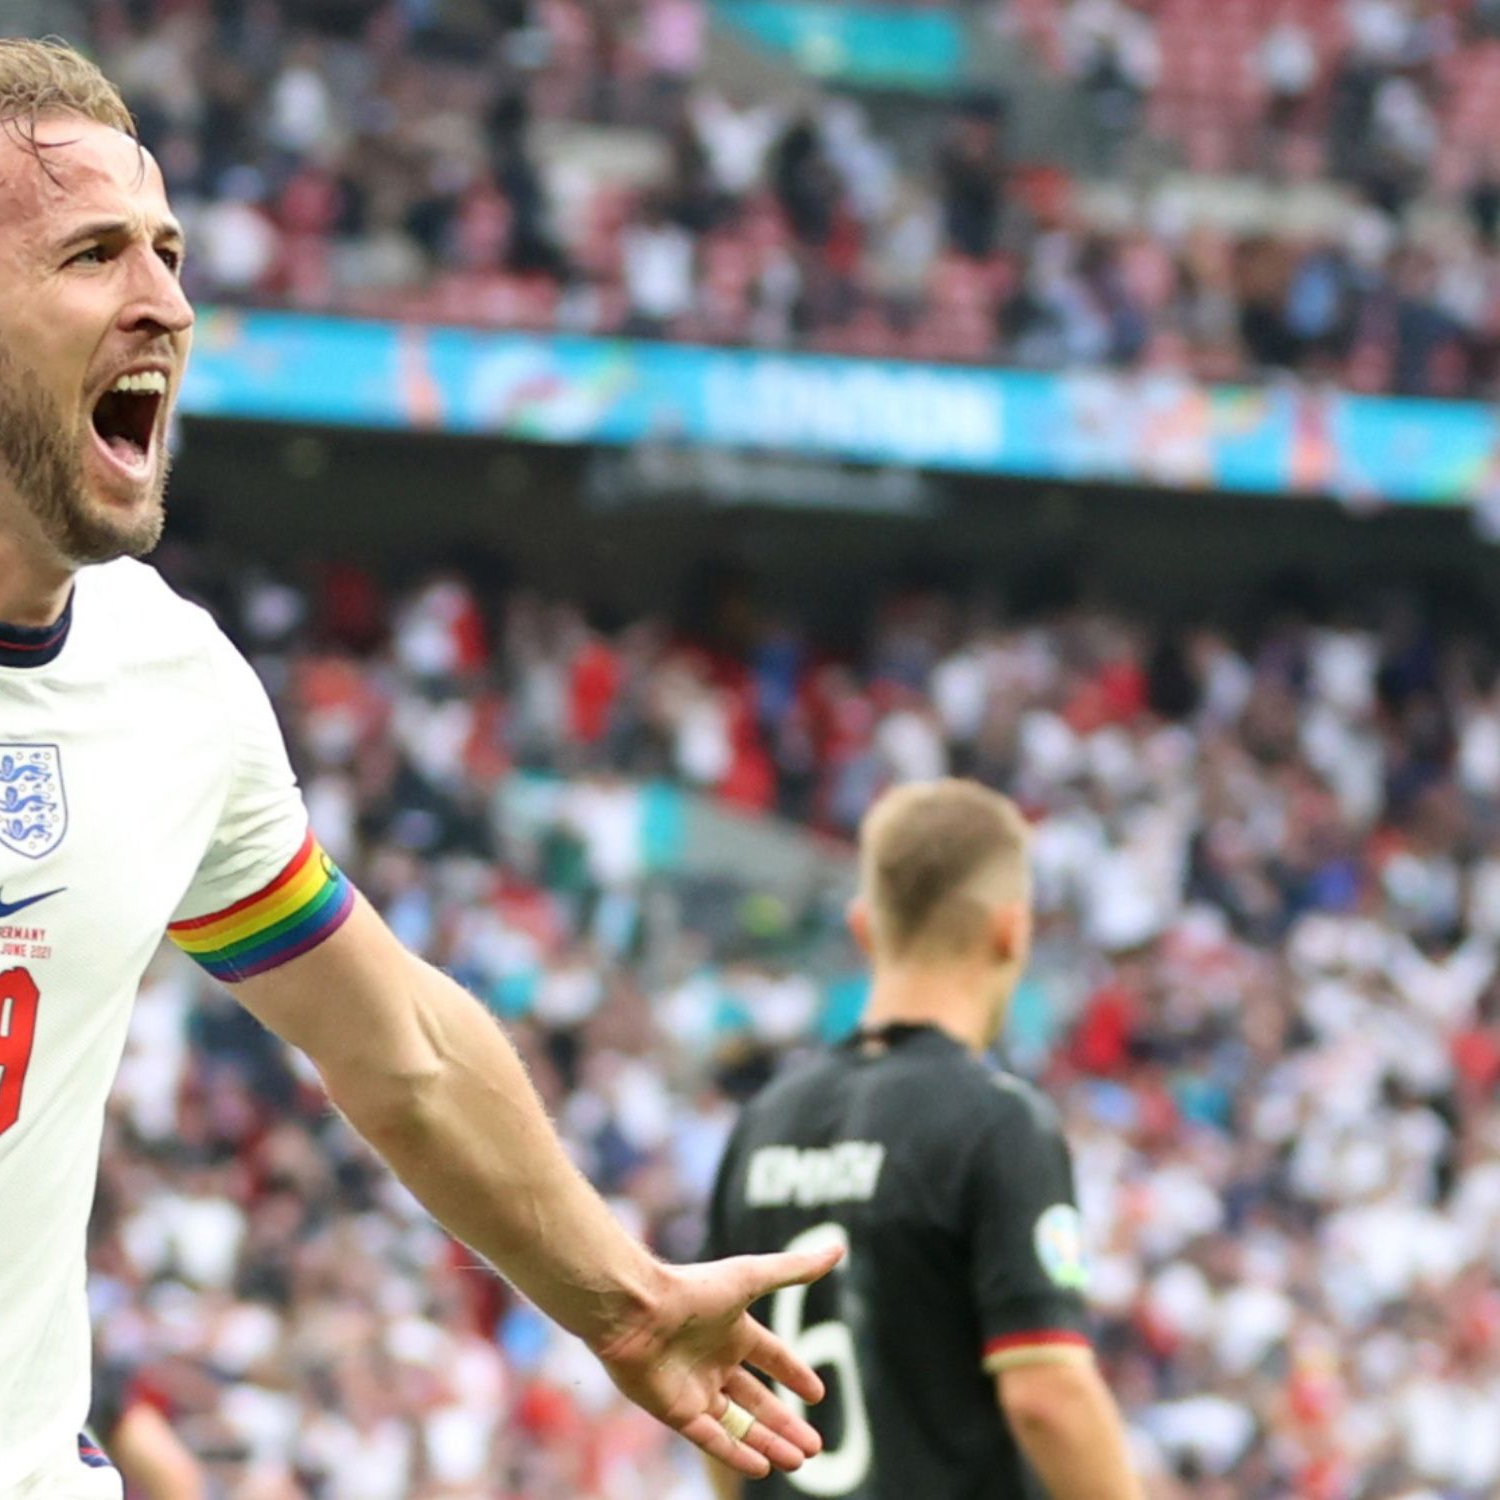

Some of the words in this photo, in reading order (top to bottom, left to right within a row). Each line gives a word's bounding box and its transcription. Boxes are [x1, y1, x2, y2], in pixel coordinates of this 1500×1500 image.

[0, 943, 27, 958] JUNE
[30, 945, 52, 959] 2021
[770, 1221, 873, 1497] 6
